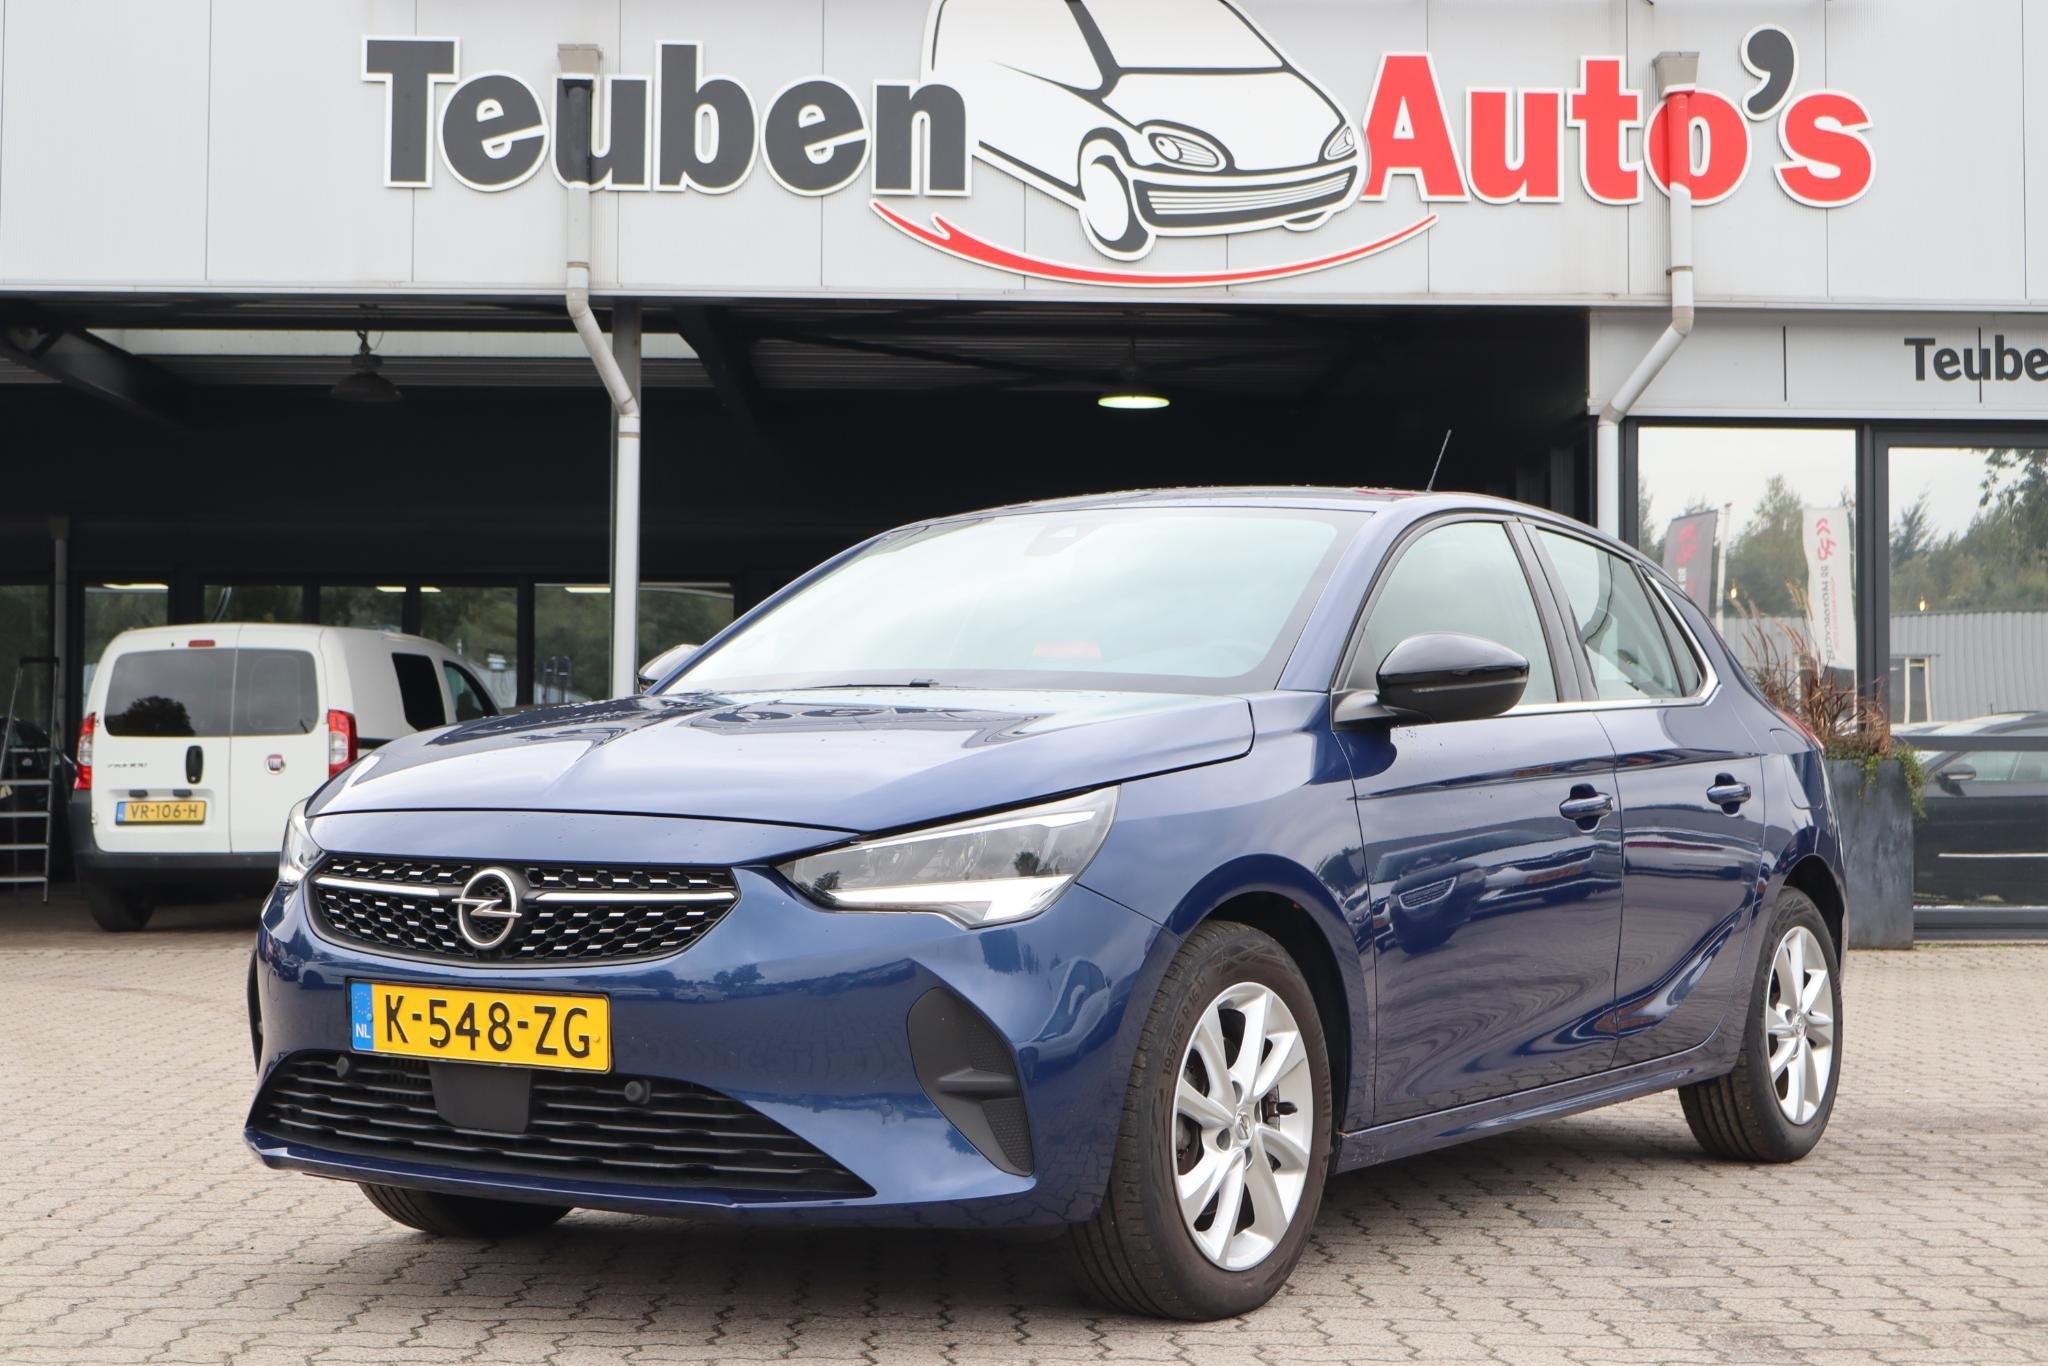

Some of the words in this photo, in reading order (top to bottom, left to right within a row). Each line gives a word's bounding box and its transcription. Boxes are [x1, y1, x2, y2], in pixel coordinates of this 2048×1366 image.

[361, 36, 972, 197] Teuben
[1361, 24, 1876, 208] Auto's
[130, 804, 198, 819] VR-106-H
[355, 1023, 372, 1039] NL
[385, 994, 591, 1059] K-548-ZG
